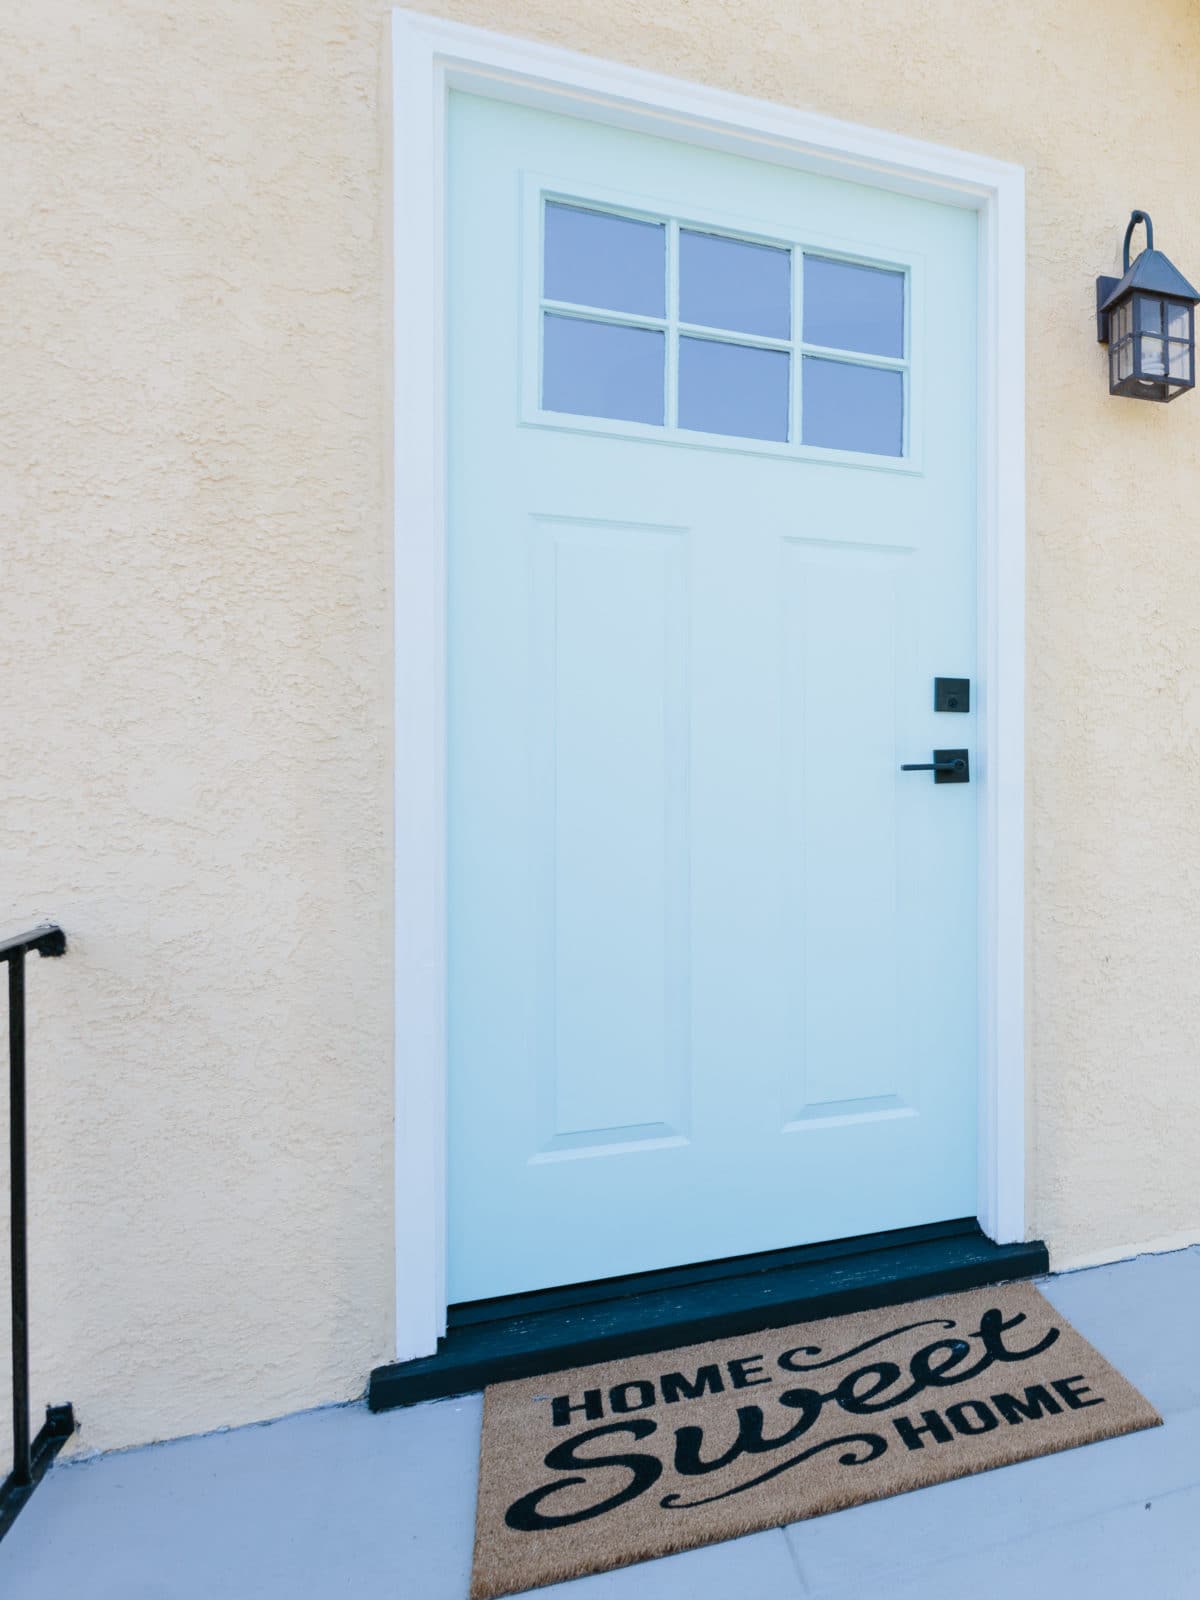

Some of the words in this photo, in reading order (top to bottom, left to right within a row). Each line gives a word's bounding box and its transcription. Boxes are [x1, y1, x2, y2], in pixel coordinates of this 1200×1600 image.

[504, 1308, 1060, 1532] Sweet
[551, 1354, 772, 1427] HOME
[900, 1375, 1105, 1450] HOME
